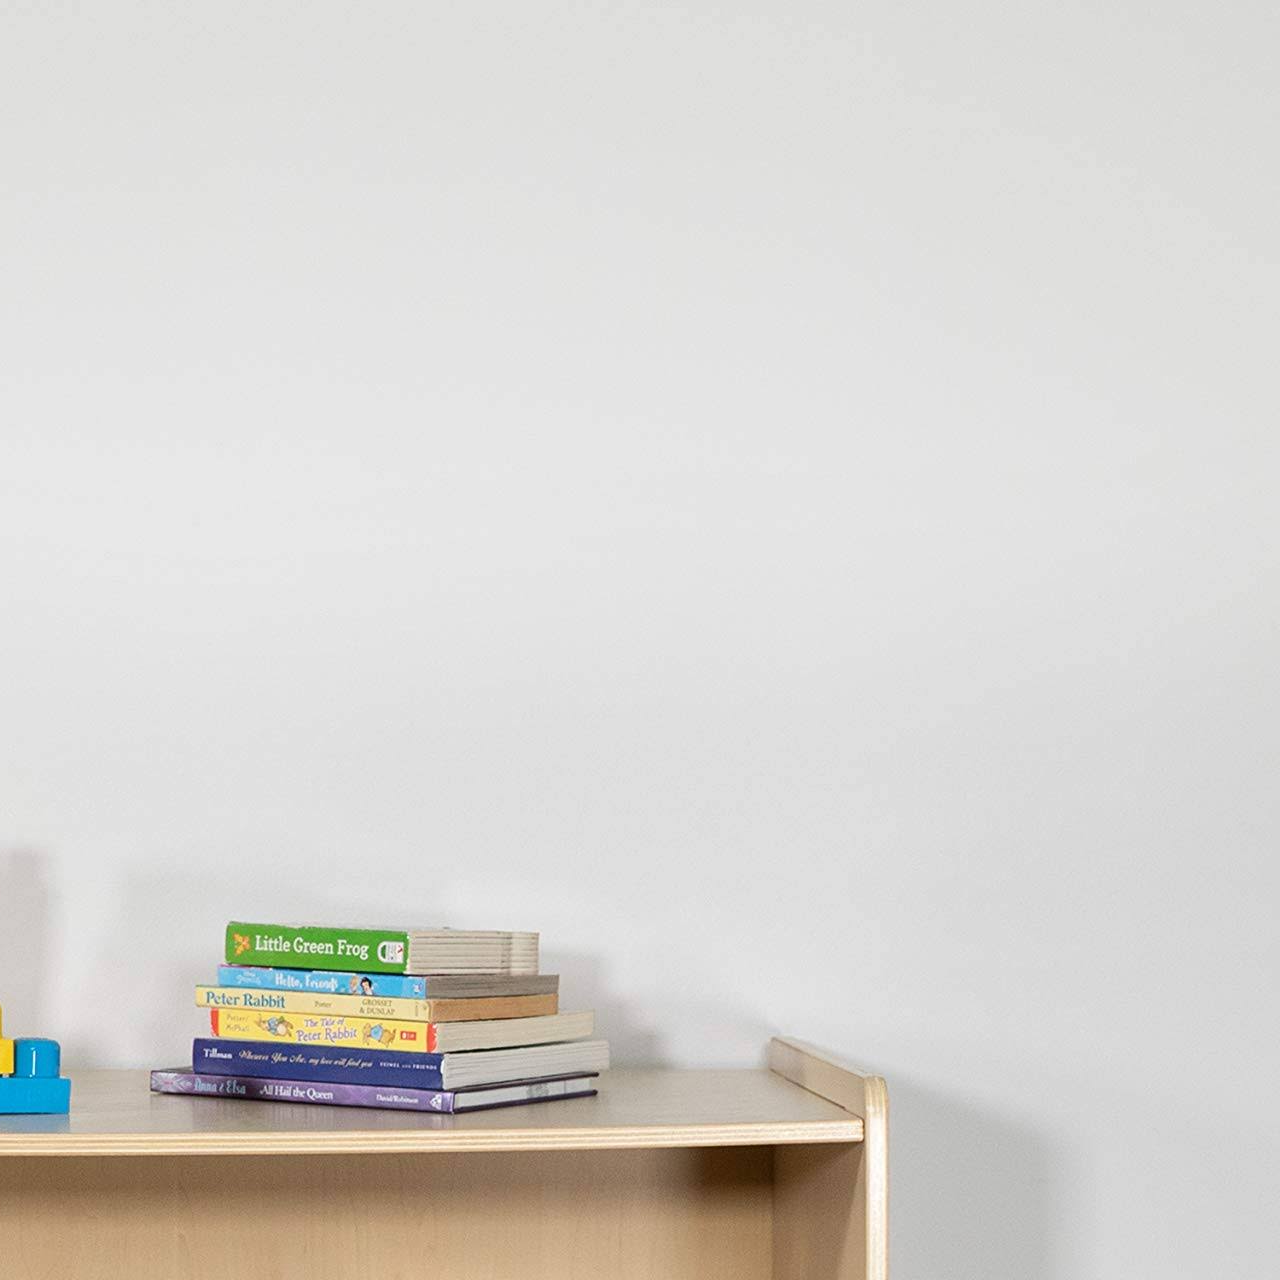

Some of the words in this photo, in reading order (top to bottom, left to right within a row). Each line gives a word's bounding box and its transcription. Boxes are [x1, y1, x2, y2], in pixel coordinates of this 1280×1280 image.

[255, 935, 291, 952] Little
[293, 937, 334, 955] Green
[337, 940, 369, 960] Frog
[206, 991, 241, 1005] Peter
[243, 994, 285, 1008] Rabbit
[362, 999, 393, 1007] GROSSET
[367, 1007, 395, 1015] DUNLAP
[304, 1019, 319, 1028] The
[321, 1018, 335, 1027] Tale
[337, 1017, 345, 1025] of
[296, 1029, 321, 1041] Peter
[325, 1029, 358, 1043] Rabbit
[203, 1048, 233, 1059] Tillman
[271, 1052, 288, 1063] You
[319, 1056, 333, 1065] love
[194, 1079, 217, 1092] Anna
[226, 1080, 246, 1094] Elsa
[260, 1084, 273, 1095] All
[274, 1085, 292, 1096] Hail
[293, 1087, 306, 1097] the
[306, 1088, 334, 1100] Queen
